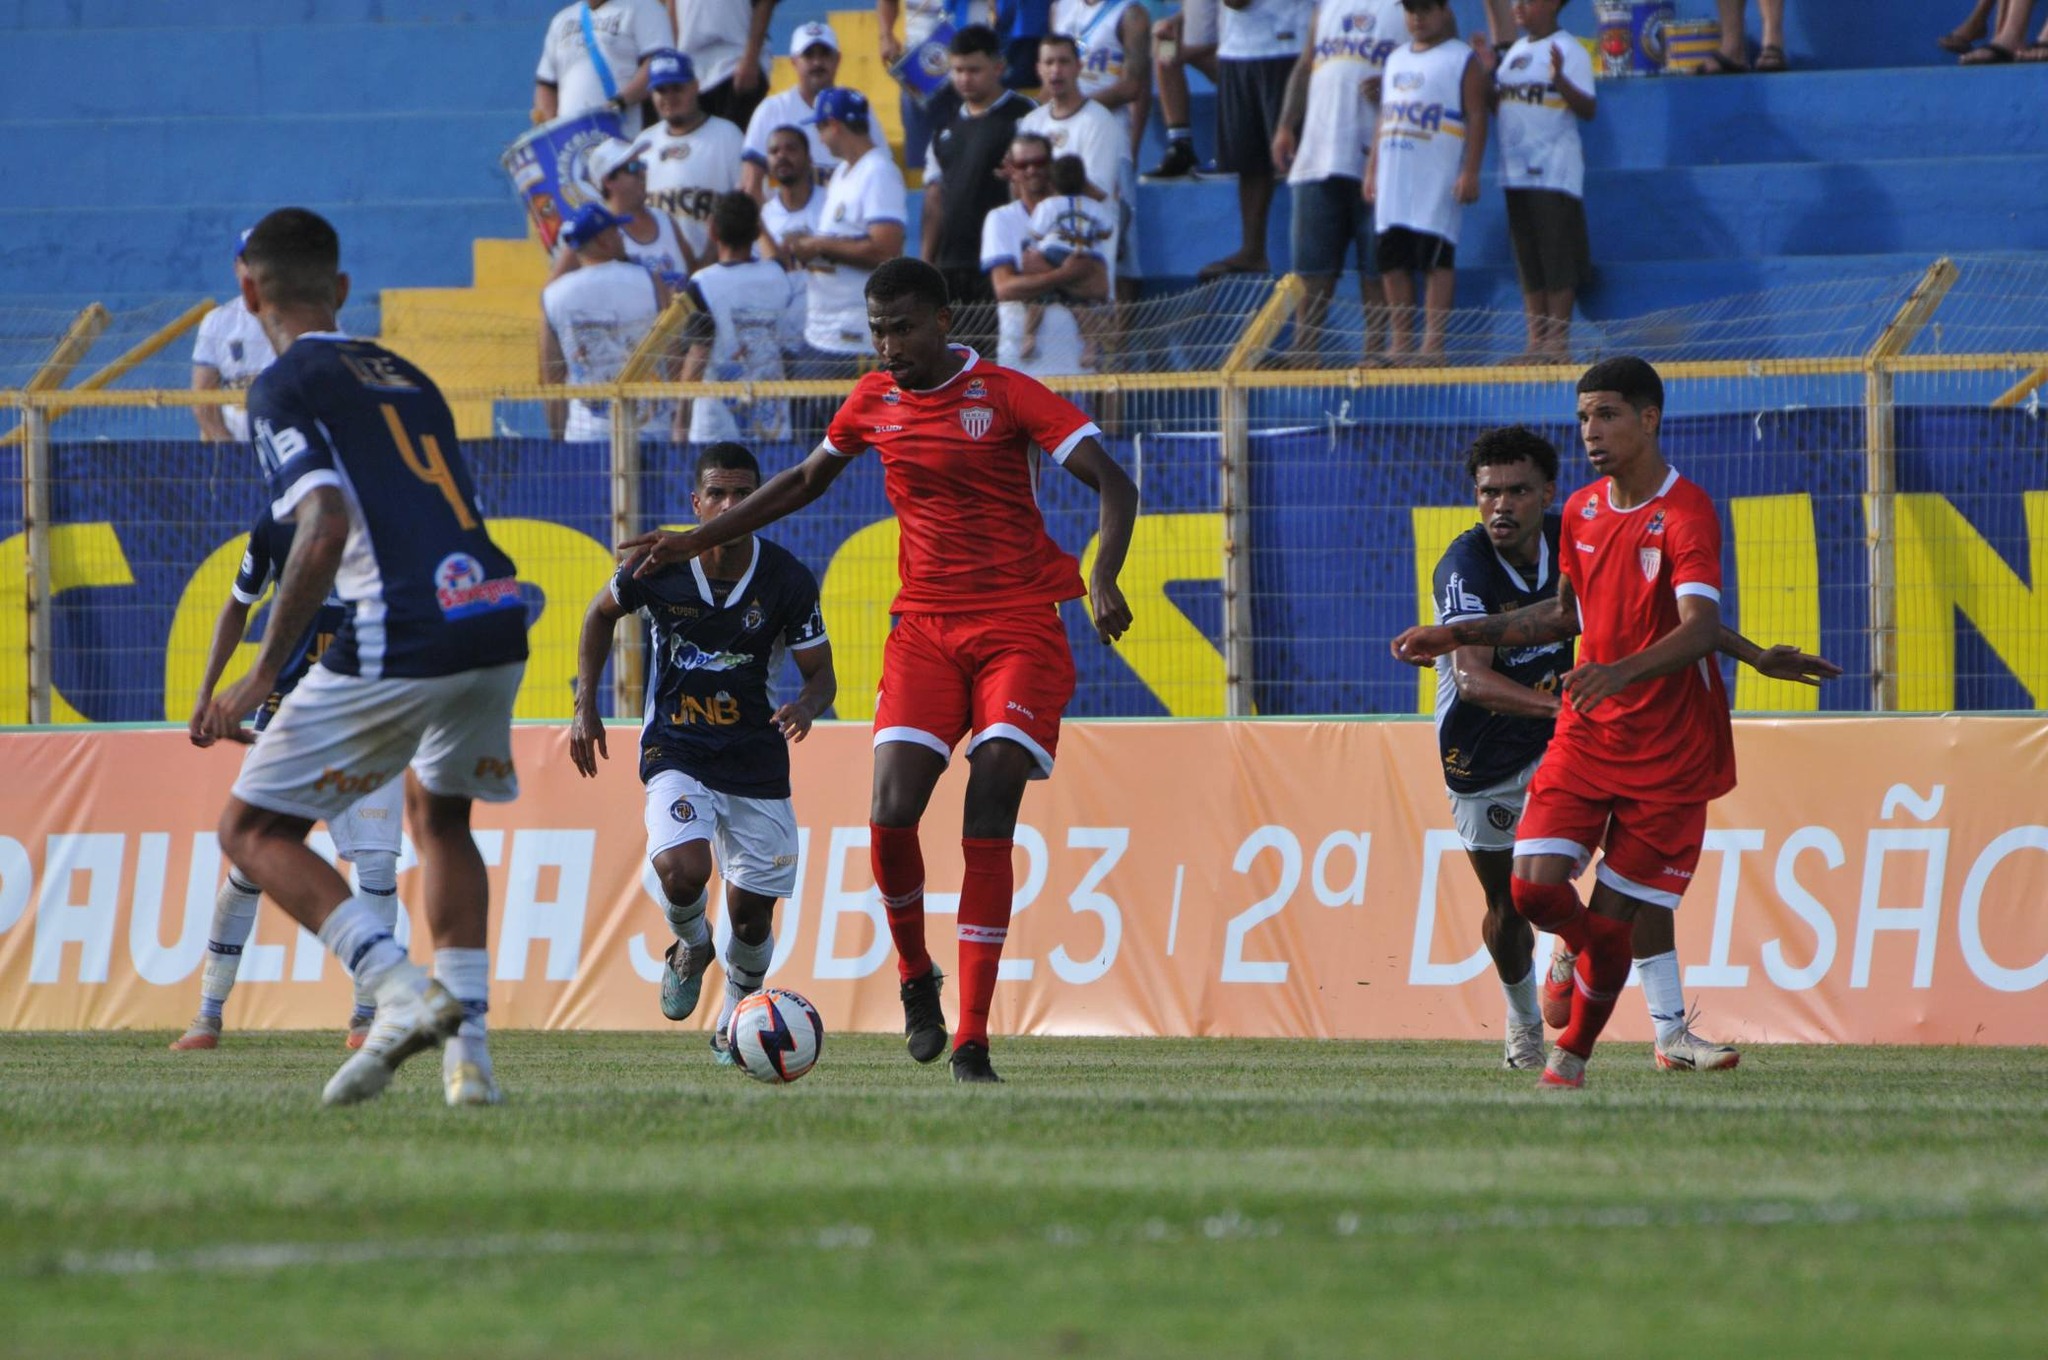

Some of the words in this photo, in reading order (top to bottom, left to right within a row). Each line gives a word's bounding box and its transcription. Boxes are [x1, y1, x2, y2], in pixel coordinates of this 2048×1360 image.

[380, 403, 478, 531] 4
[671, 693, 740, 725] JNB
[0, 829, 596, 986] AULIA
[1408, 782, 2048, 992] DISÃO
